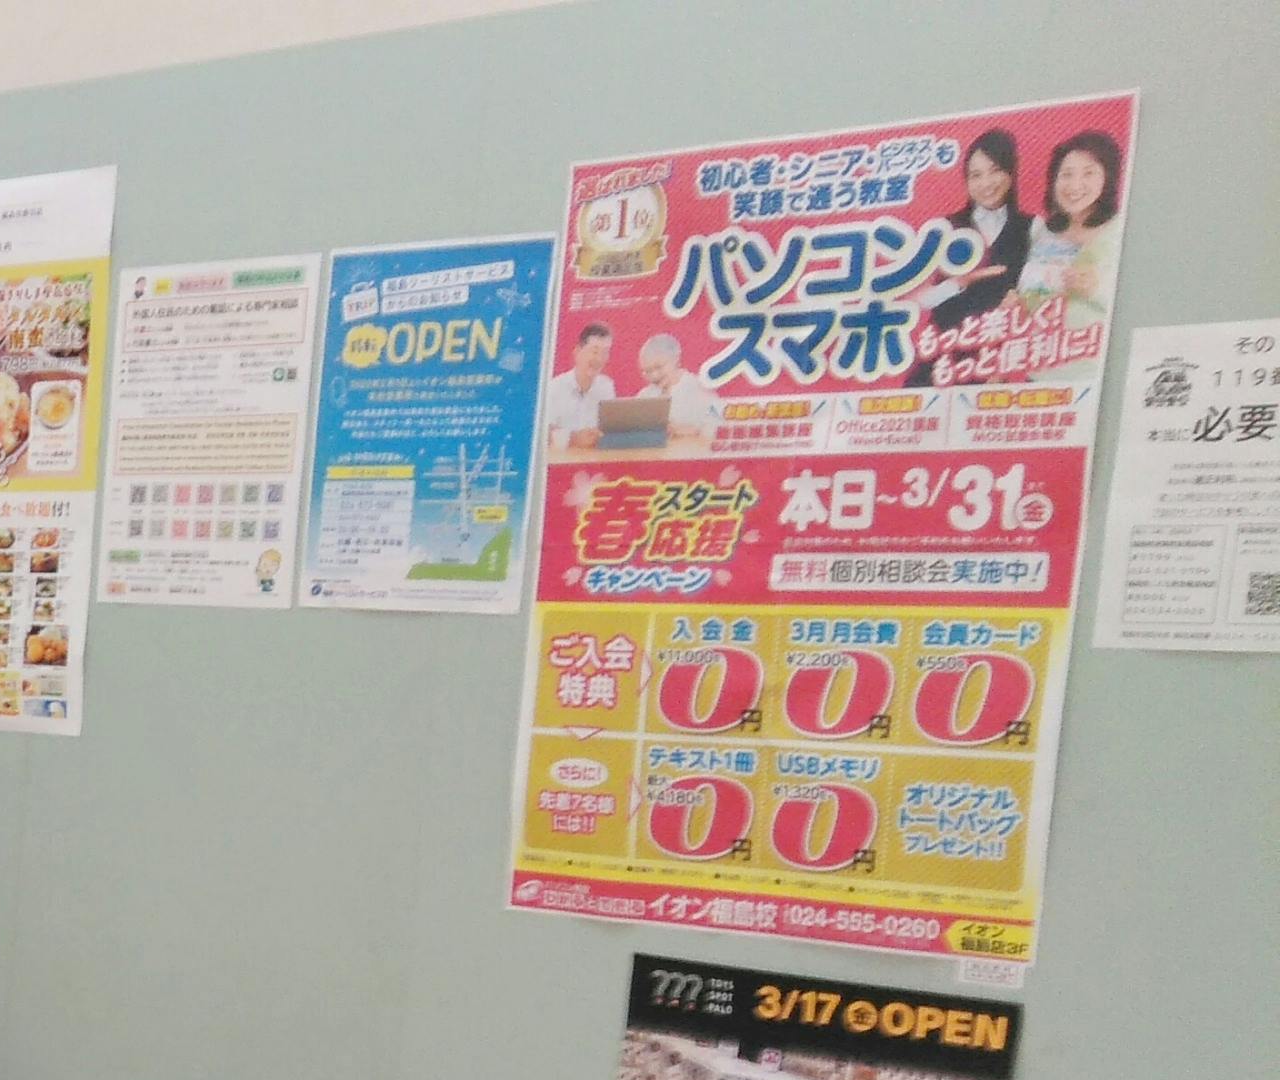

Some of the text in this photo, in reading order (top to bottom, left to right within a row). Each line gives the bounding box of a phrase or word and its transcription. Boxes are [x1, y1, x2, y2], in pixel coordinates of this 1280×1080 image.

[732, 174, 912, 219] 笑顔で通う教室
[386, 317, 502, 364] OPEN
[708, 299, 911, 381] スマホ
[918, 299, 1066, 358] もっと楽しく!
[931, 324, 1102, 384] もっと便利に!
[579, 478, 755, 563] 春 スタート
[648, 516, 742, 560] 応援
[586, 565, 713, 593] キャンペーン
[780, 558, 1044, 584] 無料個別相談会実施中!
[671, 618, 755, 642] 入会金
[923, 622, 1041, 648] 会員カード
[550, 634, 635, 670] ご入会
[557, 673, 618, 708] 特典
[648, 748, 755, 773] テキスト1冊
[777, 753, 881, 779] USBメモリ
[906, 783, 1015, 811] オリジナル
[897, 808, 1022, 836] トートバッグ
[650, 893, 780, 929] イオン福島校
[791, 907, 941, 940] 024-555-0260
[960, 922, 1006, 937] イオン
[959, 937, 1029, 956] 福島店3F
[754, 983, 842, 1027] 3/17
[878, 1001, 1010, 1051] OPEN
